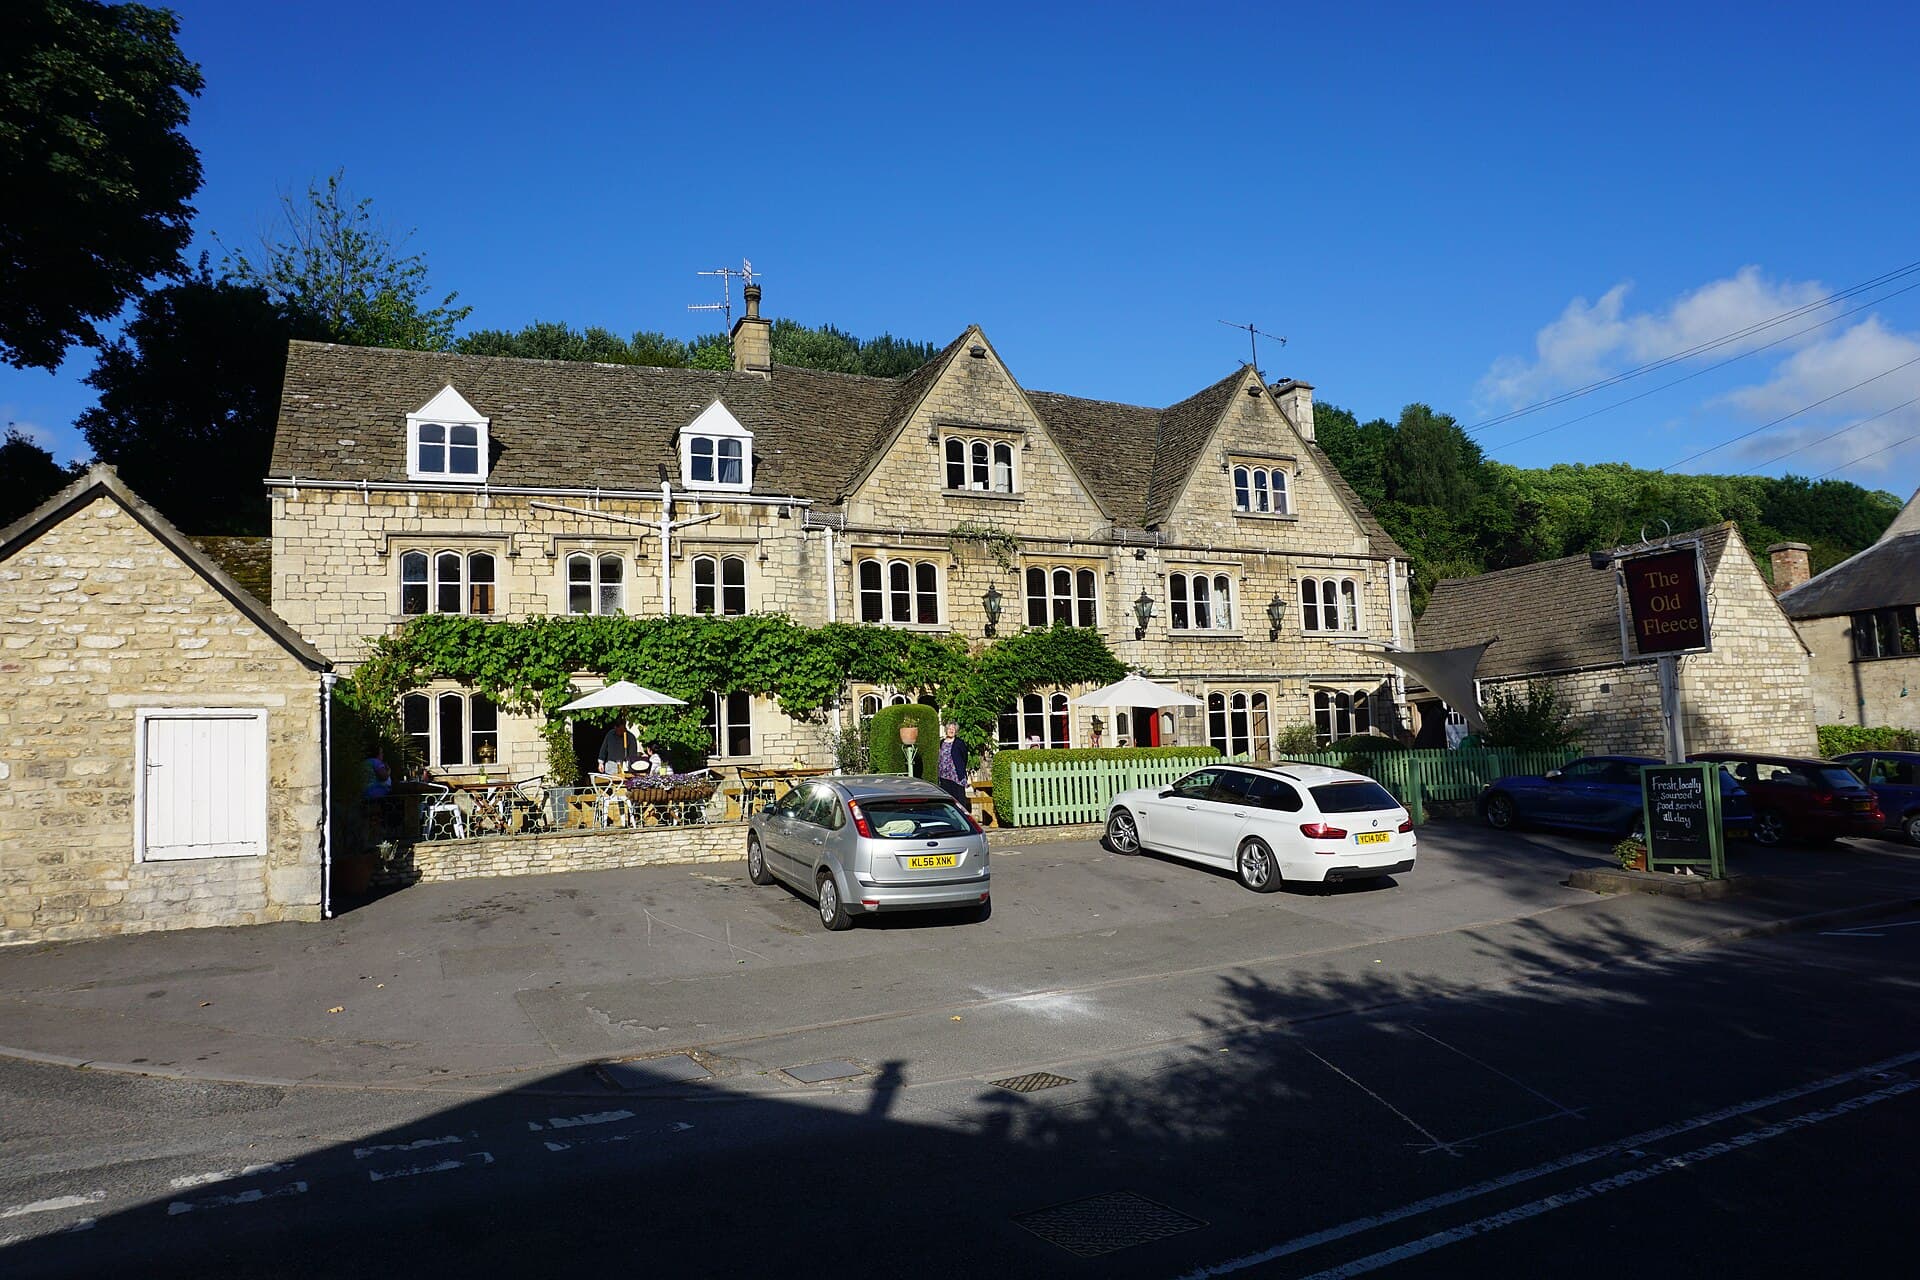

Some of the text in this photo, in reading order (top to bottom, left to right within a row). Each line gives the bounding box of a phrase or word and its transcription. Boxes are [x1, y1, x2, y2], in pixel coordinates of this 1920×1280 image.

[1644, 571, 1679, 588] The
[1651, 593, 1680, 612] Old
[1643, 617, 1698, 635] Fleece
[1679, 777, 1701, 793] locally
[1661, 790, 1693, 800] sourced
[1656, 800, 1703, 814] food served
[1663, 811, 1691, 829] all day
[911, 857, 952, 867] KL56 XNK
